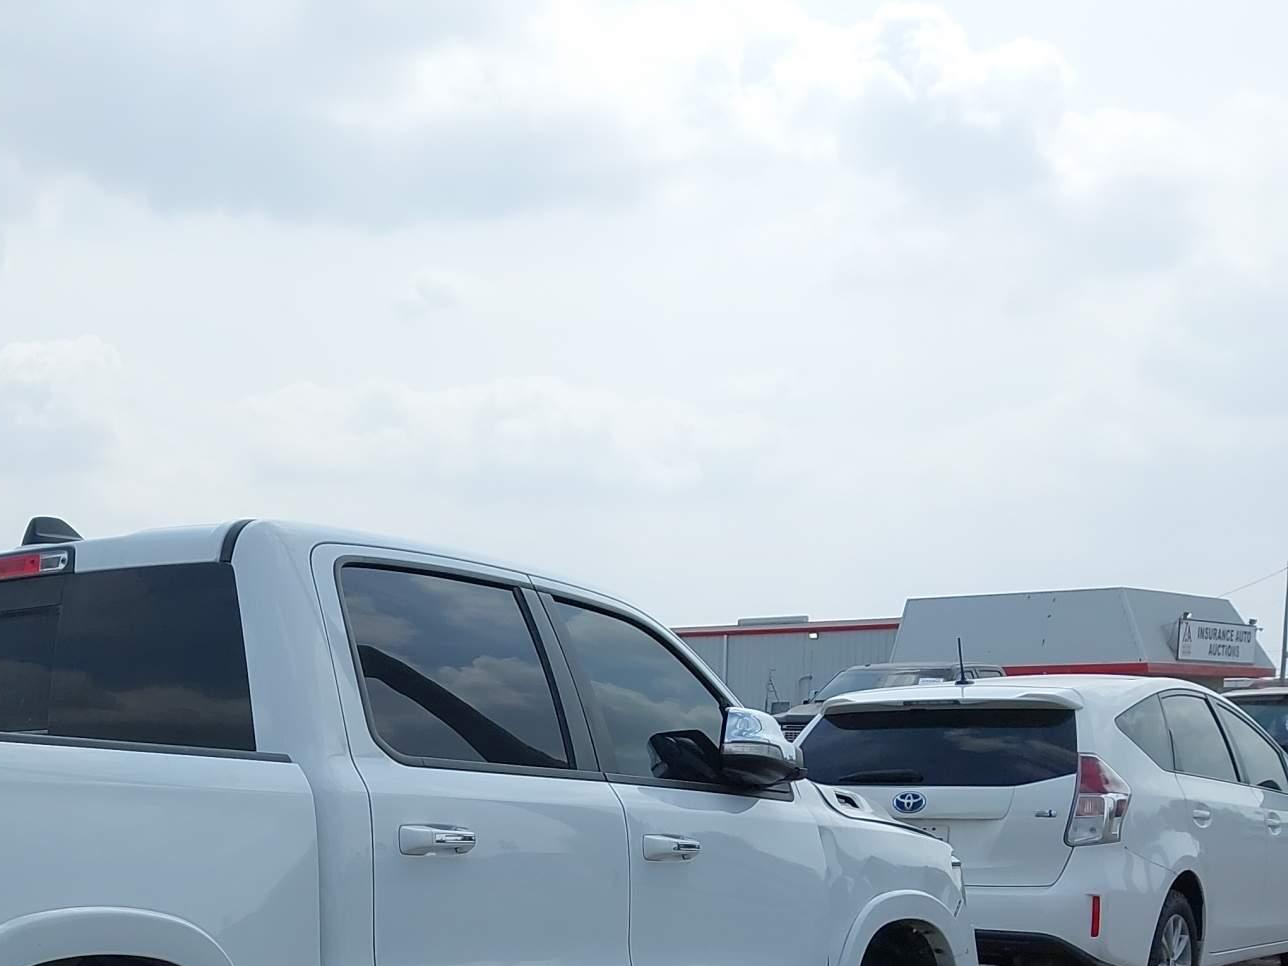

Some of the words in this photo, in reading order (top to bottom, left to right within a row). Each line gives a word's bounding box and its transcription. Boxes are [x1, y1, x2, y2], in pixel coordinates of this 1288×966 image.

[1197, 627, 1234, 642] INSURANCE
[1235, 631, 1252, 643] AUTO
[1208, 644, 1240, 658] AUCTIONS
